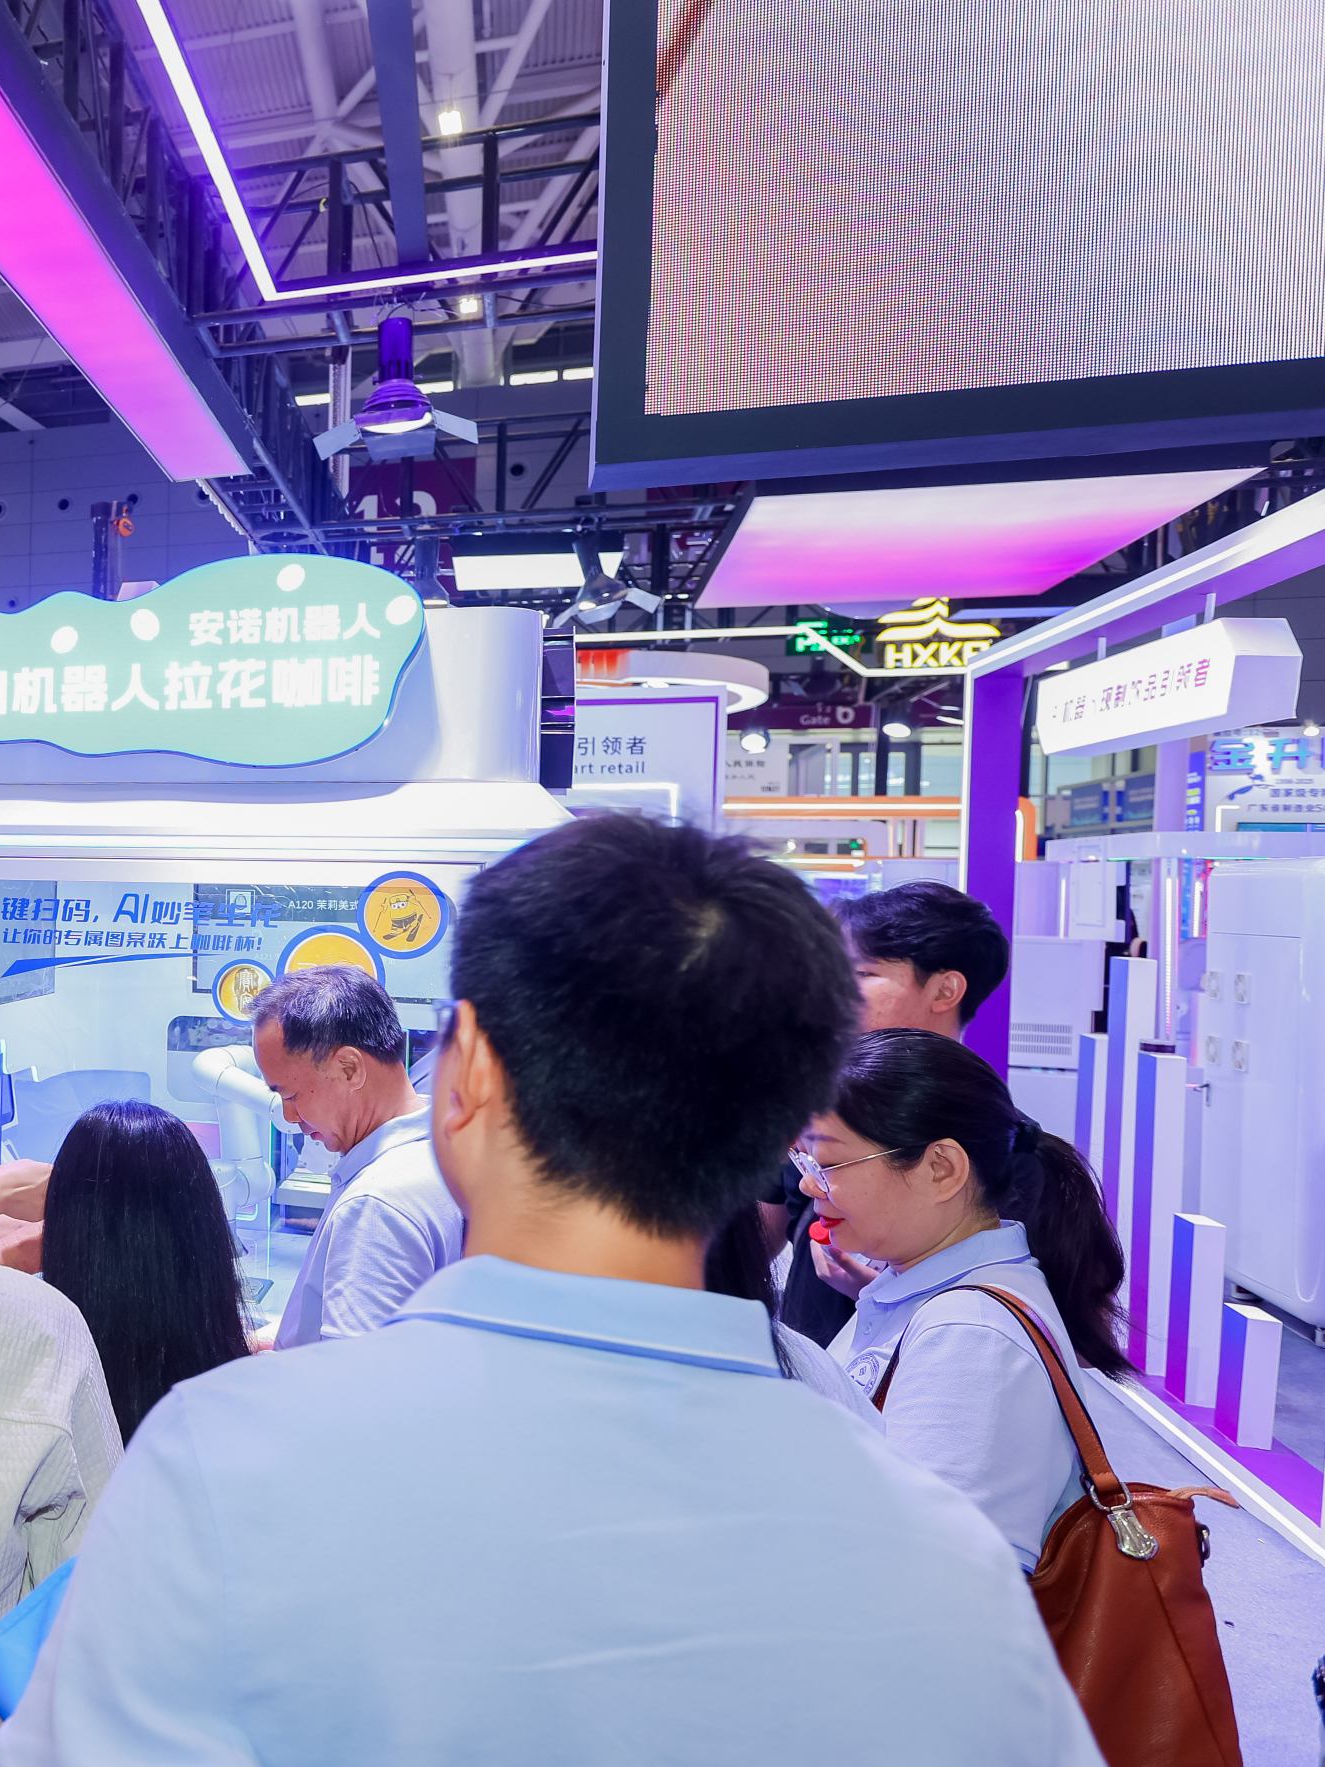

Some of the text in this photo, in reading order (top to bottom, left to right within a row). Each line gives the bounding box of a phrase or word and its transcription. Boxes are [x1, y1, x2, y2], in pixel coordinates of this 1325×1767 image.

[188, 602, 381, 646] 安诺机器人
[800, 715, 831, 726] Gate
[578, 736, 646, 755] 引领者
[601, 762, 645, 774] retail
[287, 899, 358, 911] A120 茉莉美式
